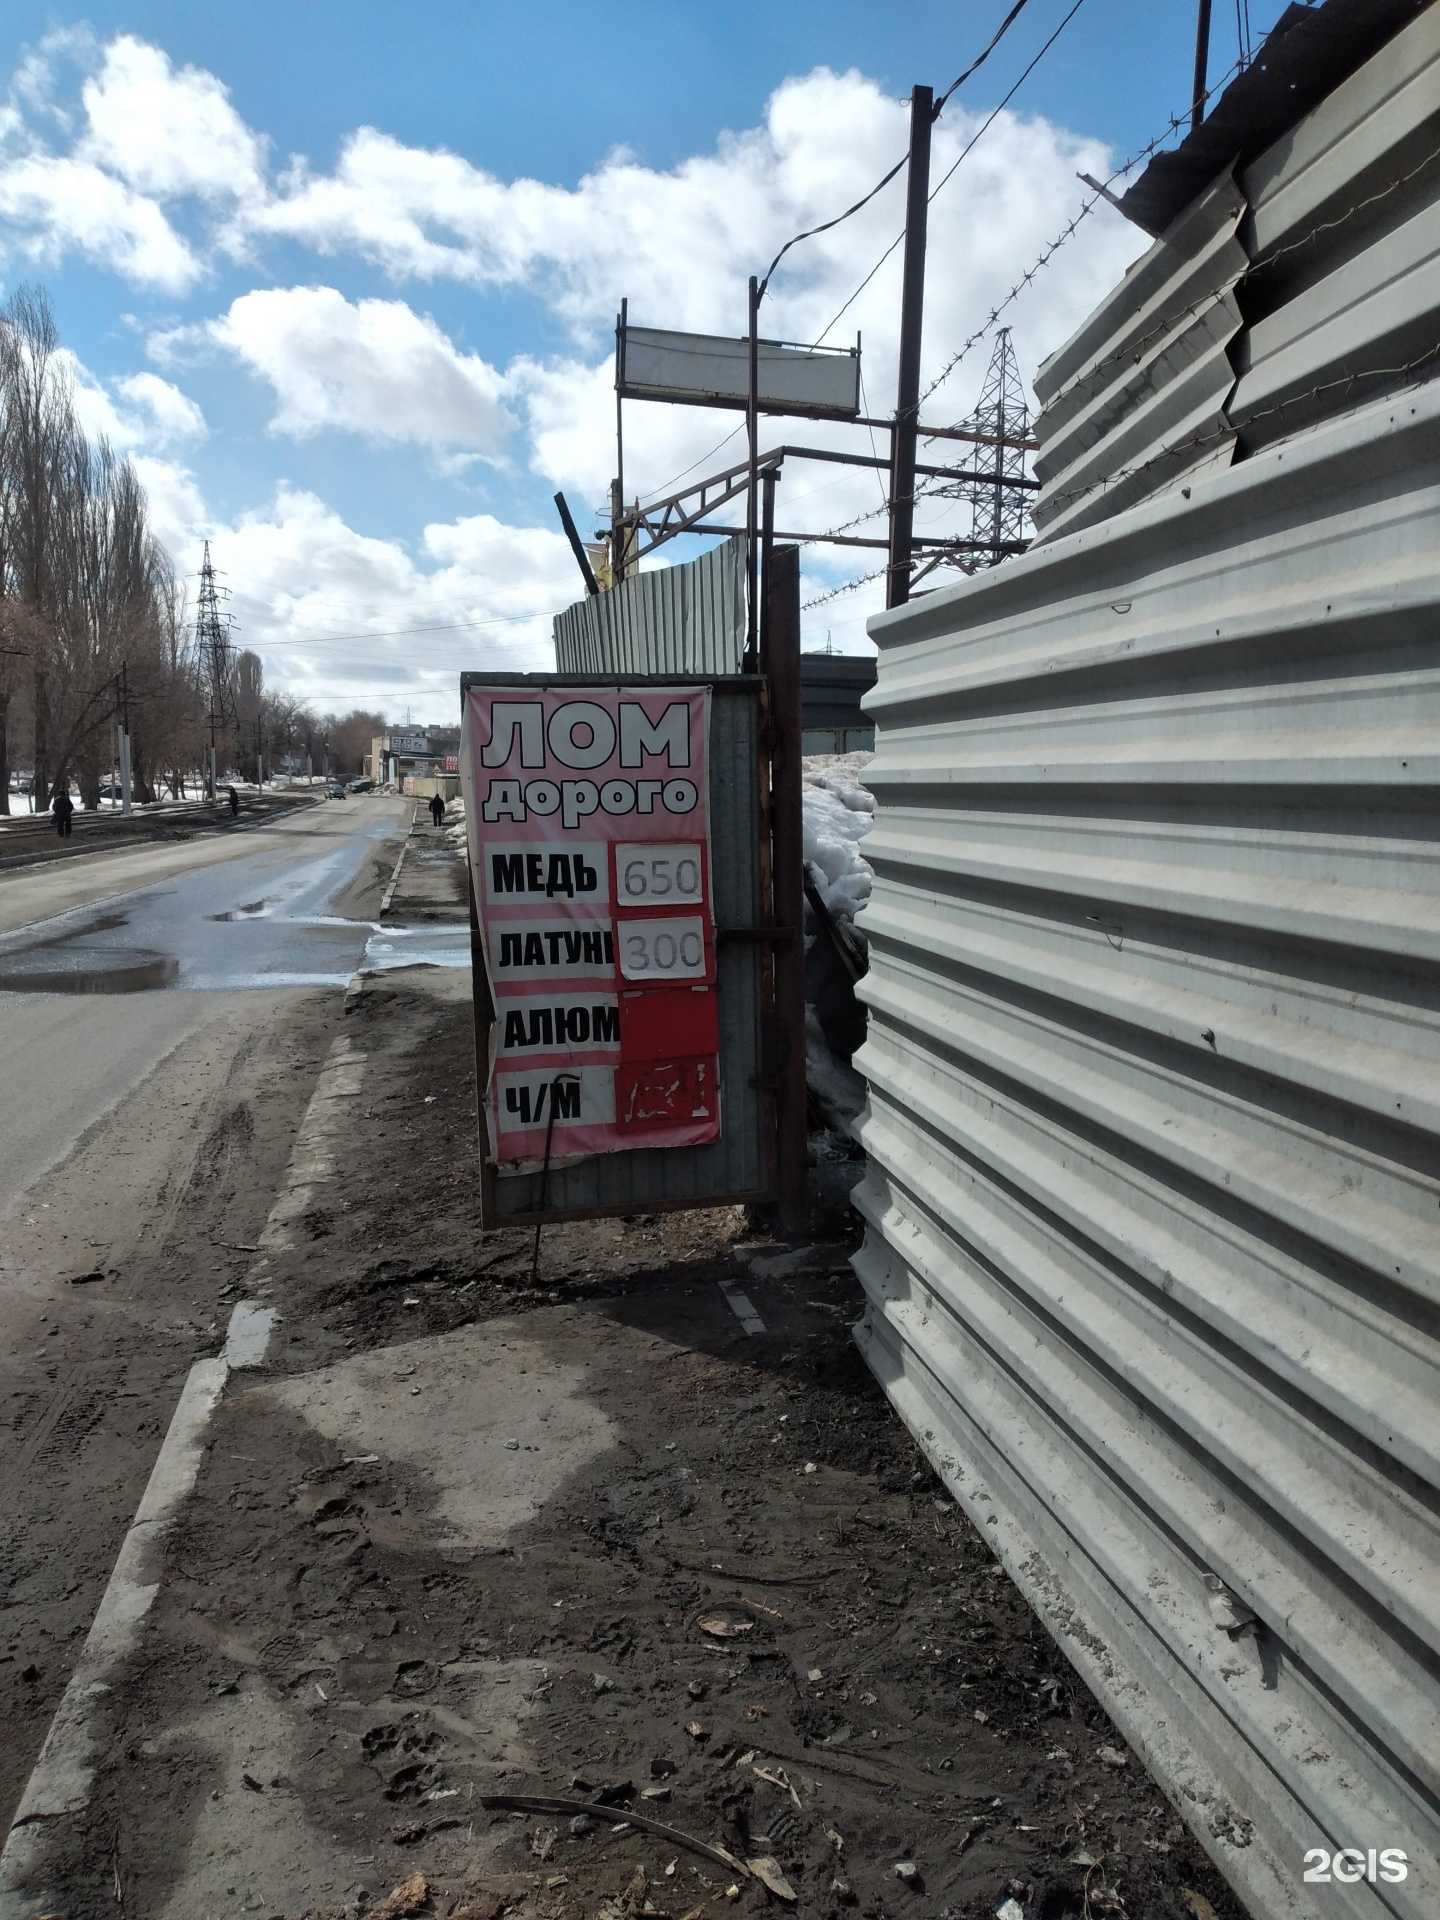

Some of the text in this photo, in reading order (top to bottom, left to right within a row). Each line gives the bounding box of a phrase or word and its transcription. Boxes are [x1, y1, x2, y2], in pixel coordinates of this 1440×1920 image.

[481, 701, 691, 770] ЛОМ
[492, 854, 597, 898] МЕДЬ
[624, 859, 698, 897] 650
[626, 931, 701, 971] 300
[504, 1006, 620, 1048] АЛЮМ
[505, 1082, 581, 1124] Ч/М
